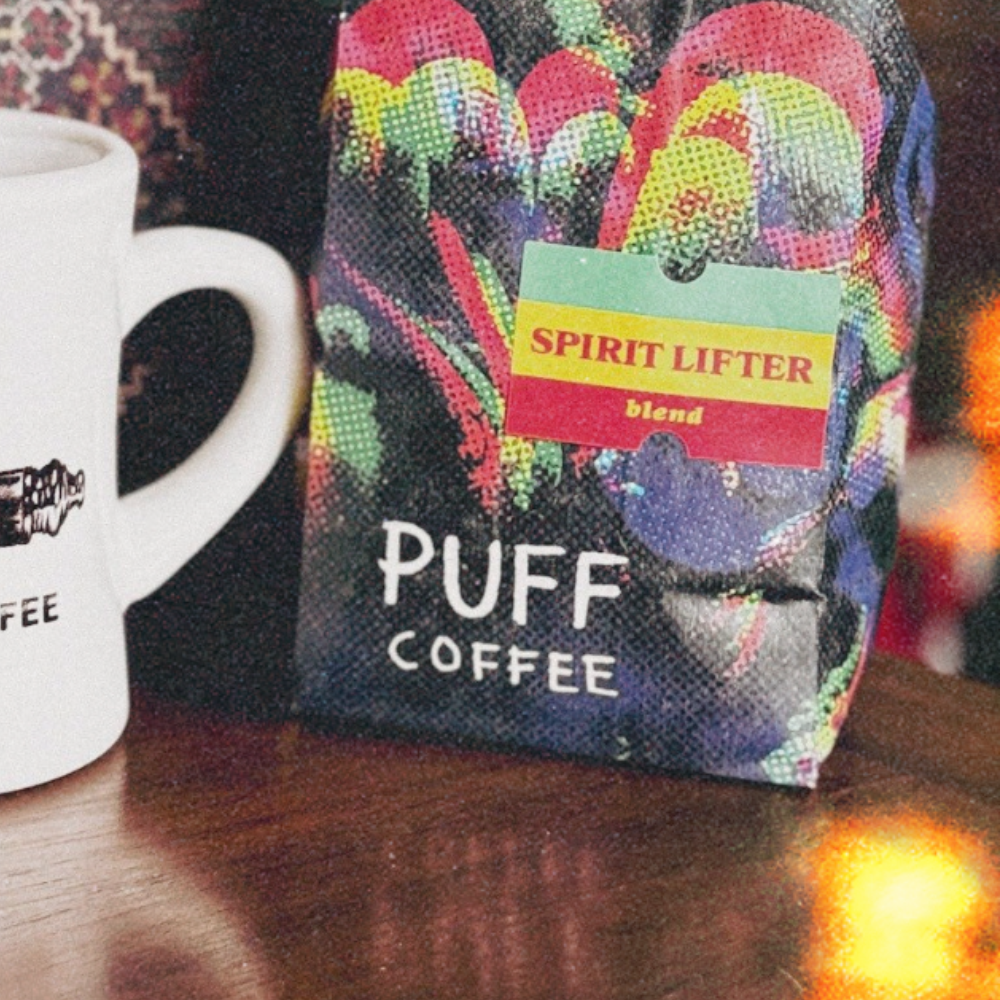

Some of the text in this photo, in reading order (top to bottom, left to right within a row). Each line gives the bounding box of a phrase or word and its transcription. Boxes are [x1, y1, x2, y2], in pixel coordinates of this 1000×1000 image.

[530, 327, 814, 385] SPIRIT LIFTER
[625, 399, 704, 426] blend
[378, 520, 630, 630] PUFF
[388, 631, 620, 698] COFFEE
